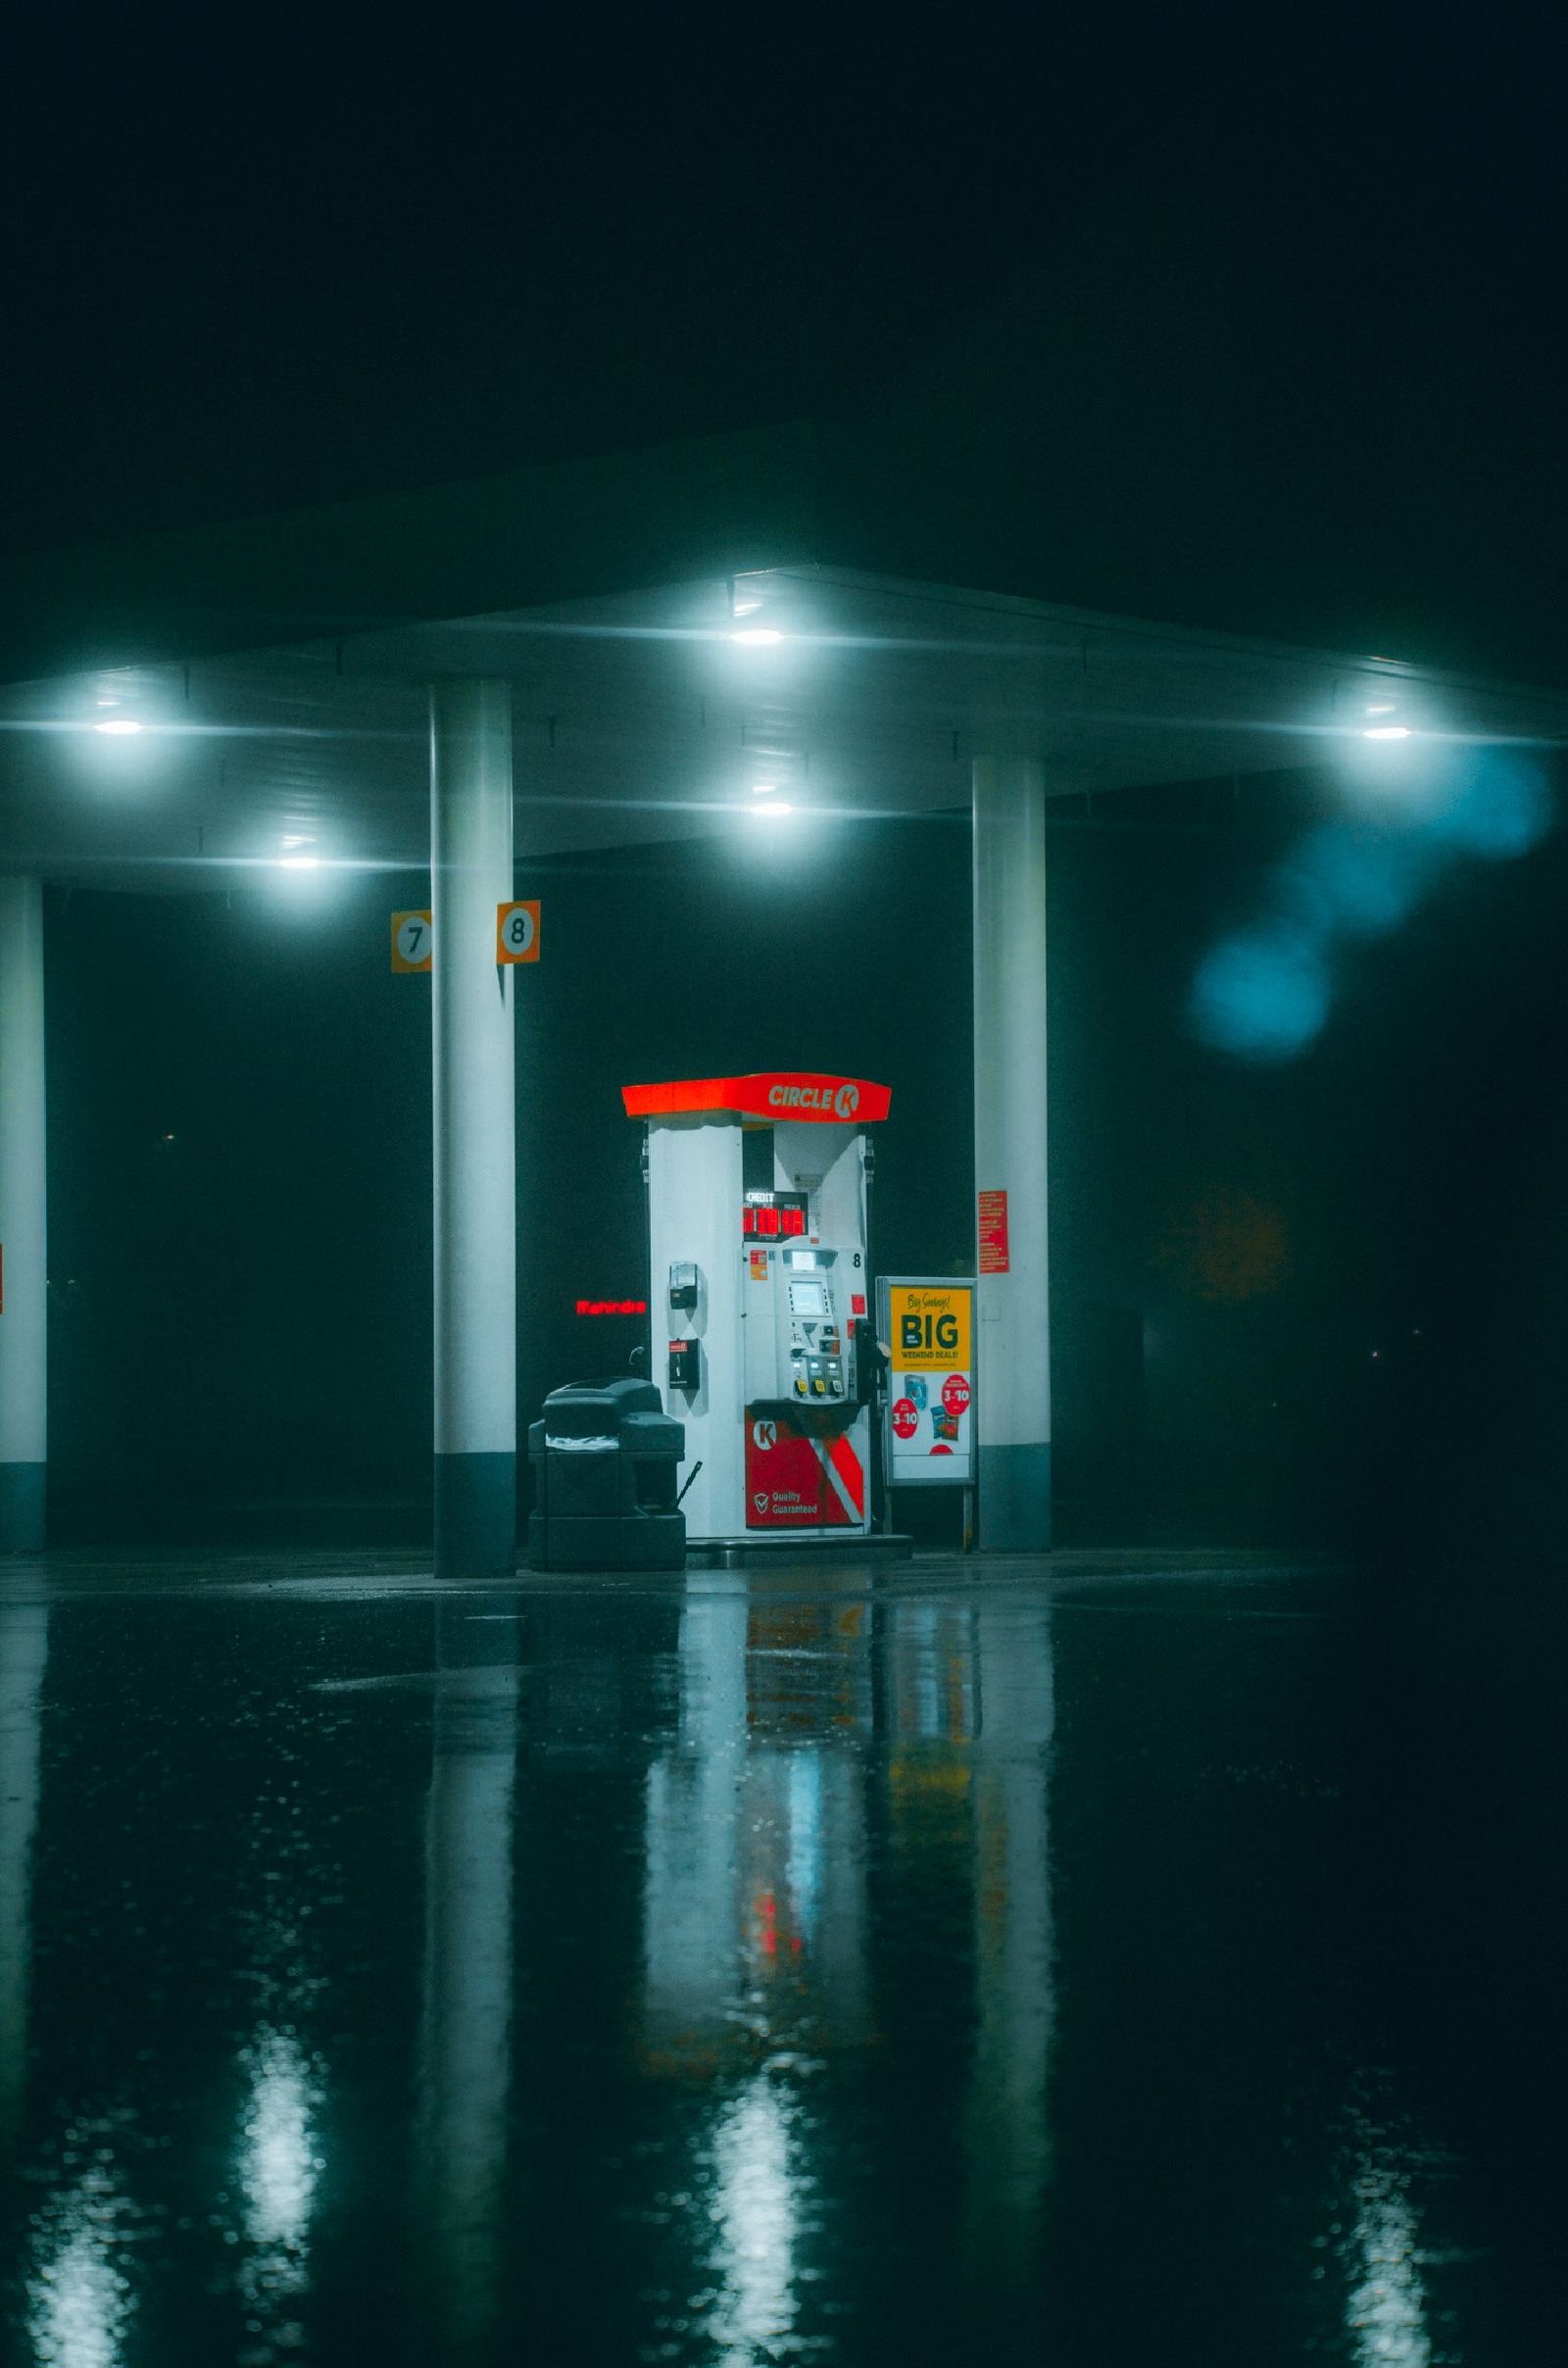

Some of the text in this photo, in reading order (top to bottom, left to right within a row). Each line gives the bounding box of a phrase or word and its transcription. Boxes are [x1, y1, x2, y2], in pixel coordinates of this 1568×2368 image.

[511, 917, 525, 944] 8
[407, 926, 423, 954] 7
[768, 1085, 859, 1118] CIRCLE K
[854, 1253, 861, 1268] 8
[907, 1293, 921, 1313] Big
[902, 1314, 958, 1350] BIG
[902, 1351, 934, 1359] WEEKEND
[944, 1390, 951, 1402] 3
[893, 1412, 901, 1425] 3
[772, 1492, 801, 1503] Quality
[772, 1505, 817, 1514] Guaranteed
